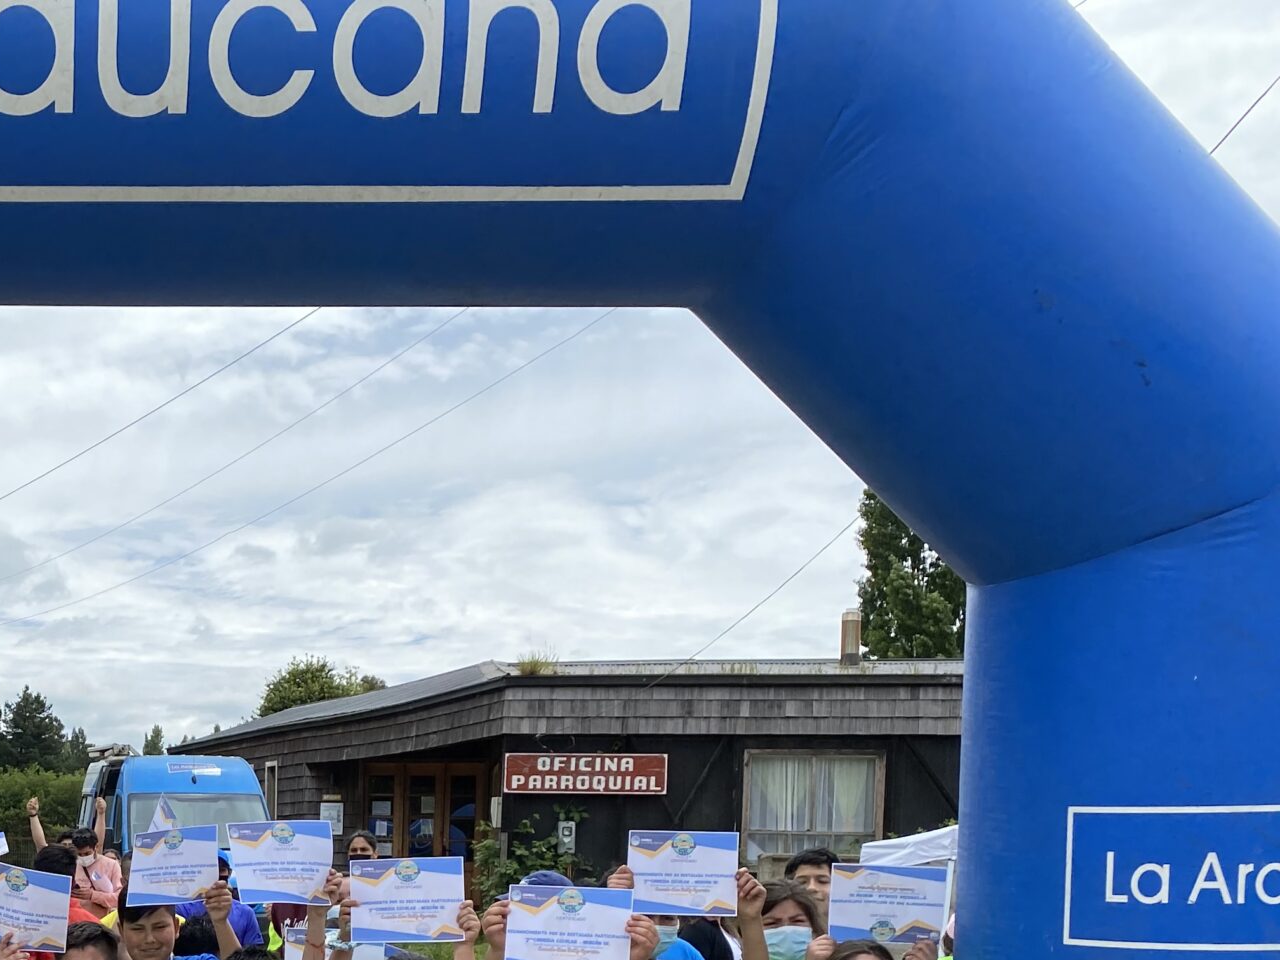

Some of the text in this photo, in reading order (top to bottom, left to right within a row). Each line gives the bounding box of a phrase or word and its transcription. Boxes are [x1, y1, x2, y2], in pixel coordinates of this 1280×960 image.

[536, 756, 634, 772] OFICINA
[511, 774, 662, 792] PARROQUIAL
[1105, 851, 1170, 904] La
